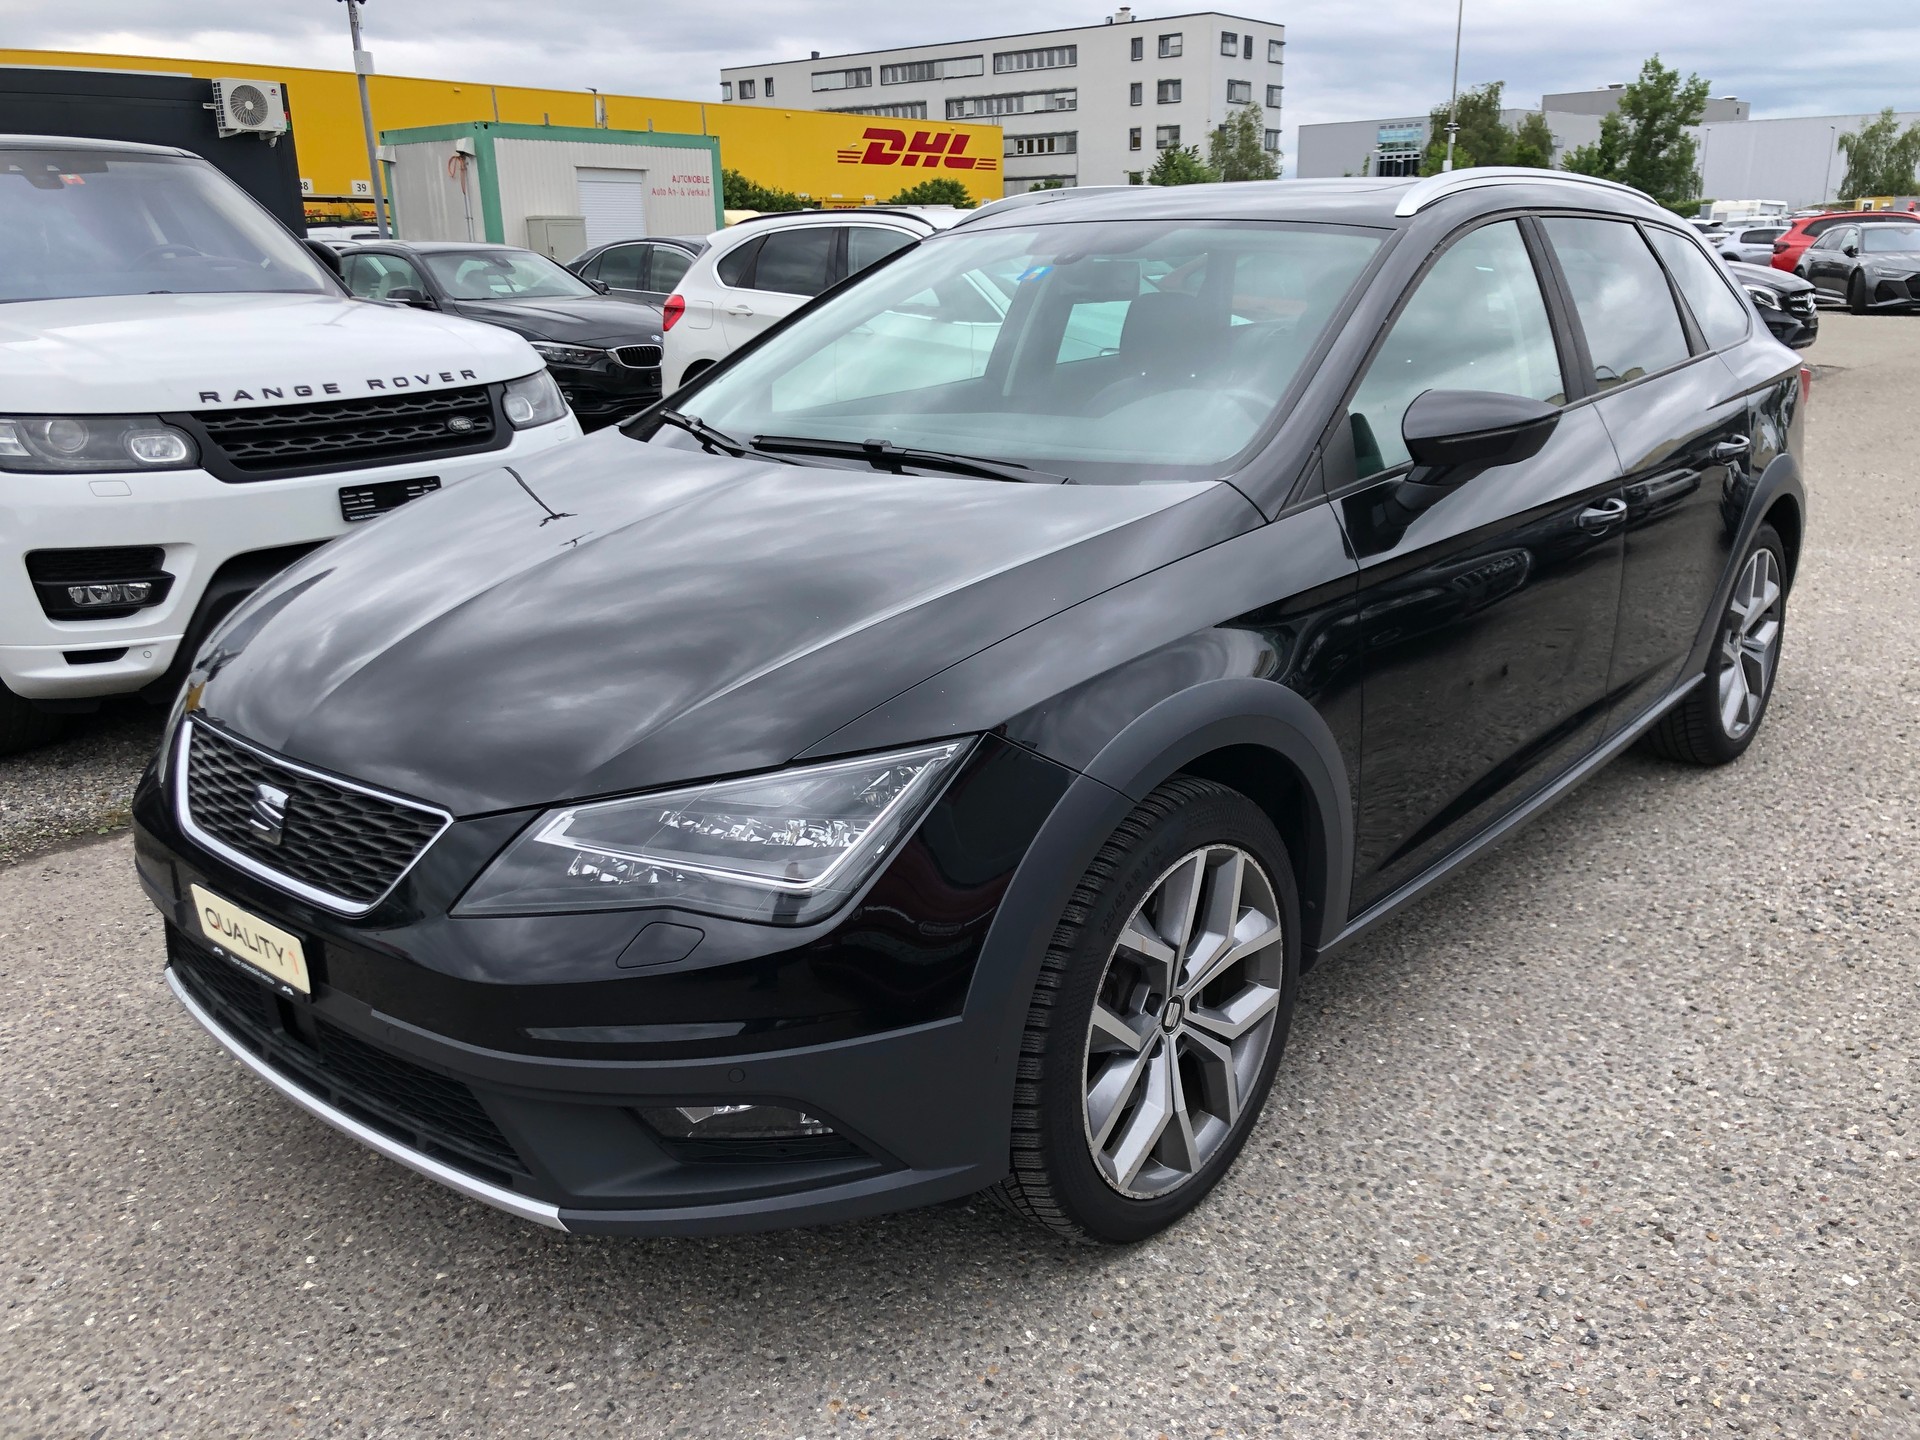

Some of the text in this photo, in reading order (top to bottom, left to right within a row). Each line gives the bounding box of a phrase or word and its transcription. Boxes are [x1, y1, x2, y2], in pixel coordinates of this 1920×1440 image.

[861, 128, 977, 169] DHL
[356, 183, 367, 192] 39
[672, 175, 710, 184] AUTOMOBILE
[651, 187, 667, 196] Auto
[687, 188, 711, 197] Verkauf
[199, 369, 478, 403] RANGE ROVER
[205, 907, 284, 967] QUALITY
